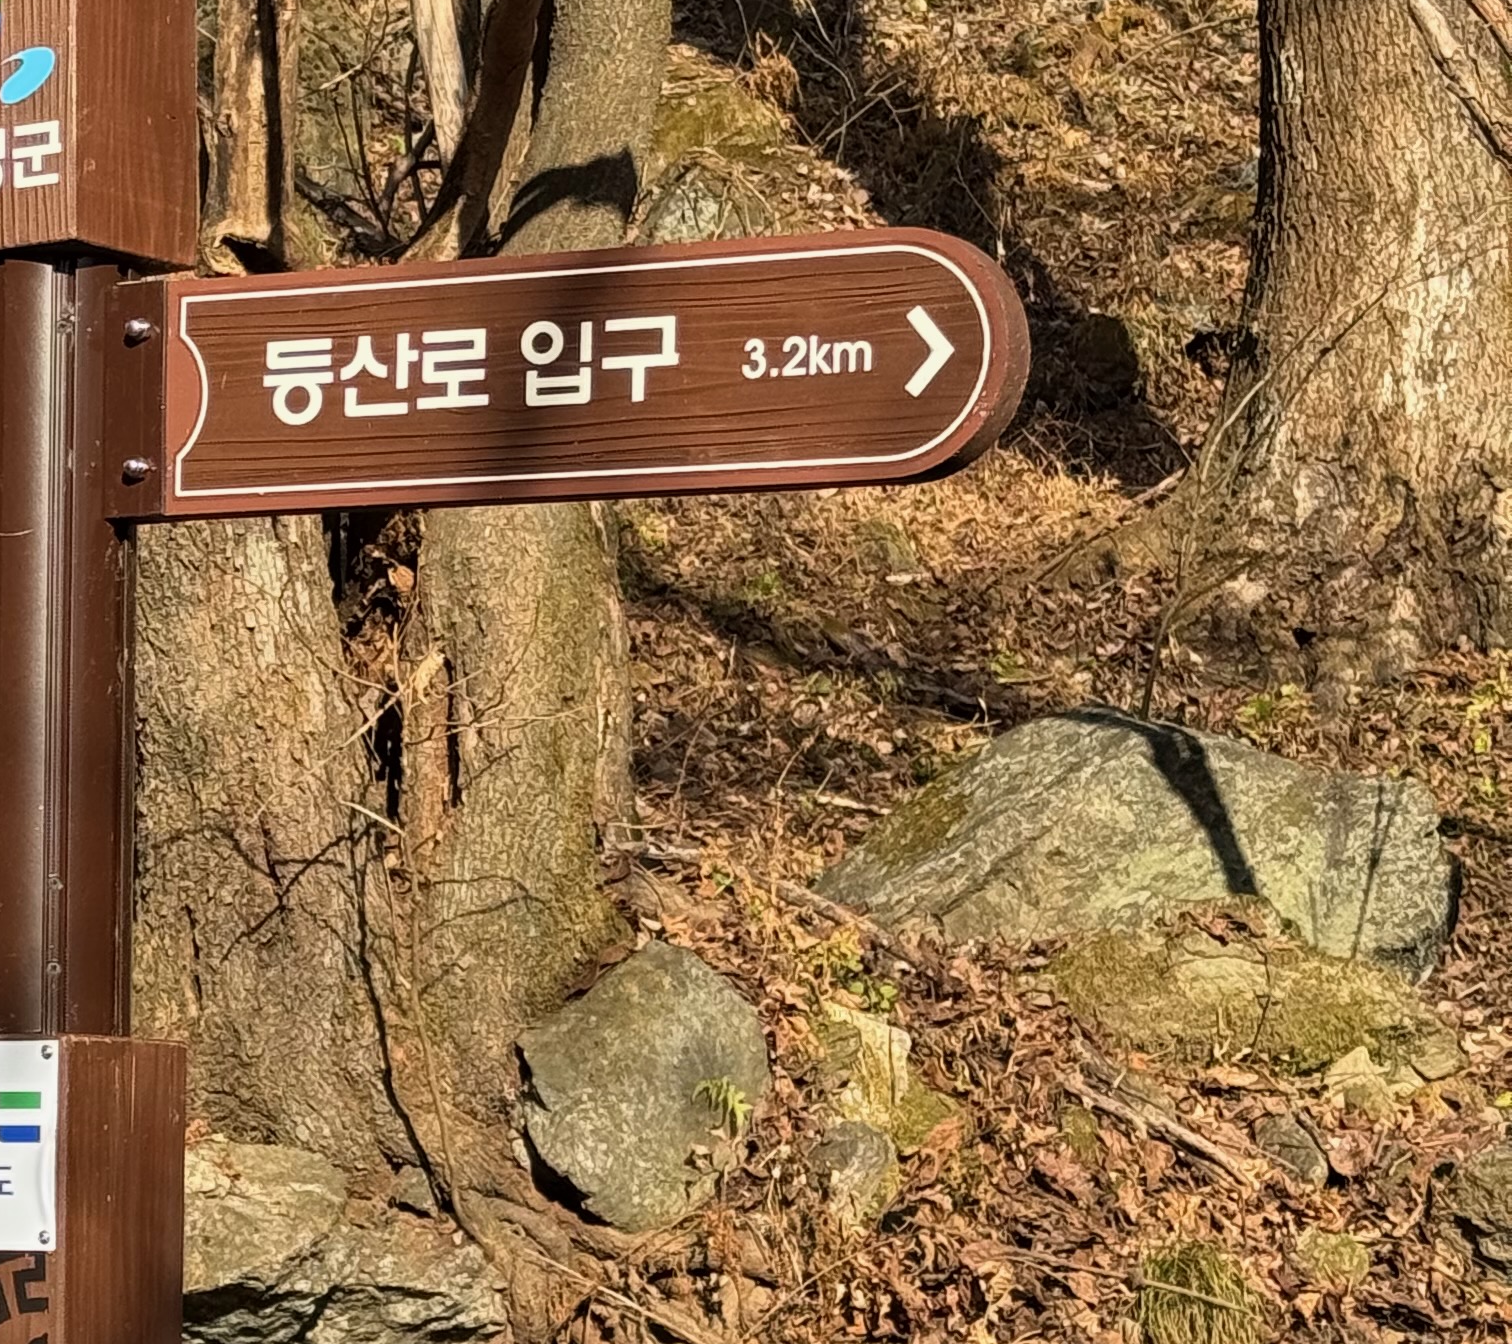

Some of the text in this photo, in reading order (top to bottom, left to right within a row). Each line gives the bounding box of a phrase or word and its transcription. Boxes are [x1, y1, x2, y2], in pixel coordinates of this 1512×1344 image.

[262, 315, 873, 426] 등산로 입구 3.2km
